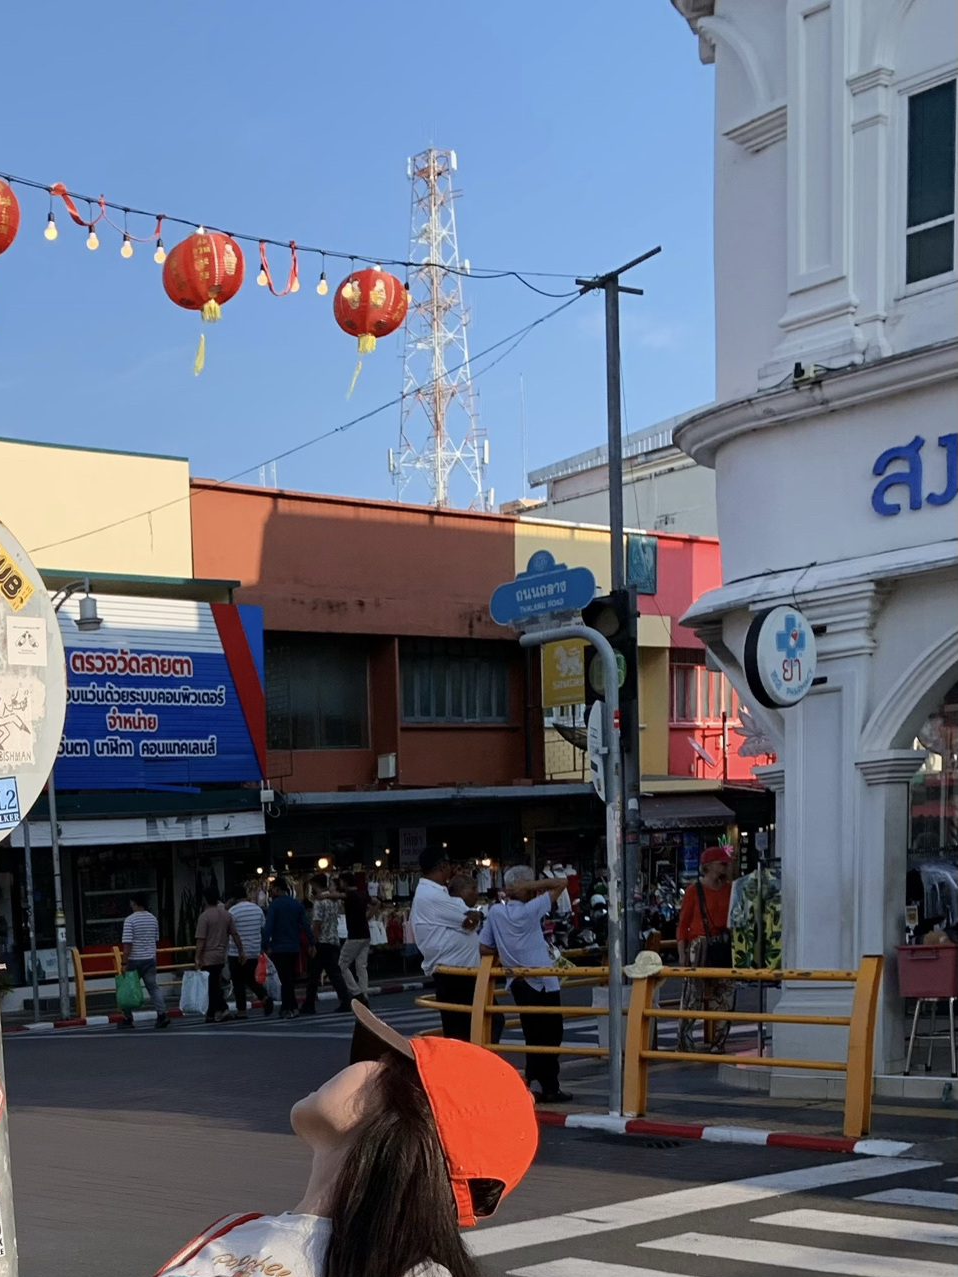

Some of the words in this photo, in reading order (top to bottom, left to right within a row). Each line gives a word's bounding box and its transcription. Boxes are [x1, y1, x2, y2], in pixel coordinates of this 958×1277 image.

[71, 650, 193, 677] ตรวจวัดสายตา
[782, 658, 802, 681] ยา
[107, 707, 158, 732] จำหน่าย
[58, 736, 90, 757] ว่นตา
[95, 737, 133, 757] นาฬิกา
[140, 735, 216, 758] คอนแทคเลนส์
